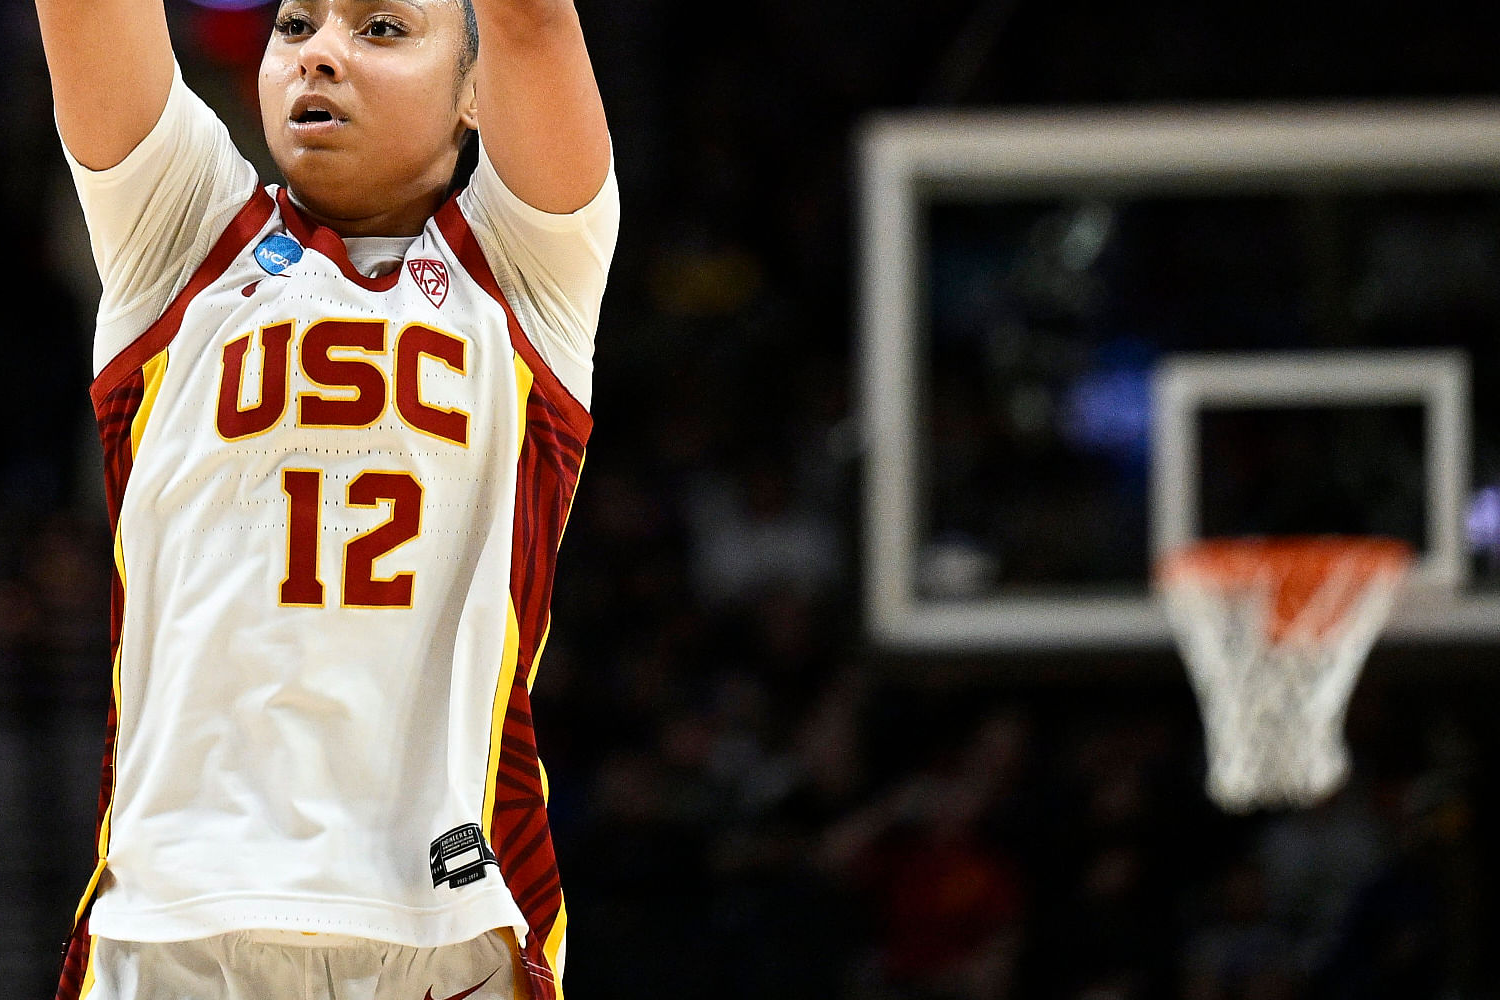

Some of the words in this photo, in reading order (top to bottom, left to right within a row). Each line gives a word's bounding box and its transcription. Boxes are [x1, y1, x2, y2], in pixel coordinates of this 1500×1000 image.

[258, 247, 290, 269] NCA
[408, 259, 446, 286] PAC
[422, 278, 443, 296] 12
[215, 318, 471, 449] USC
[277, 467, 425, 610] 12
